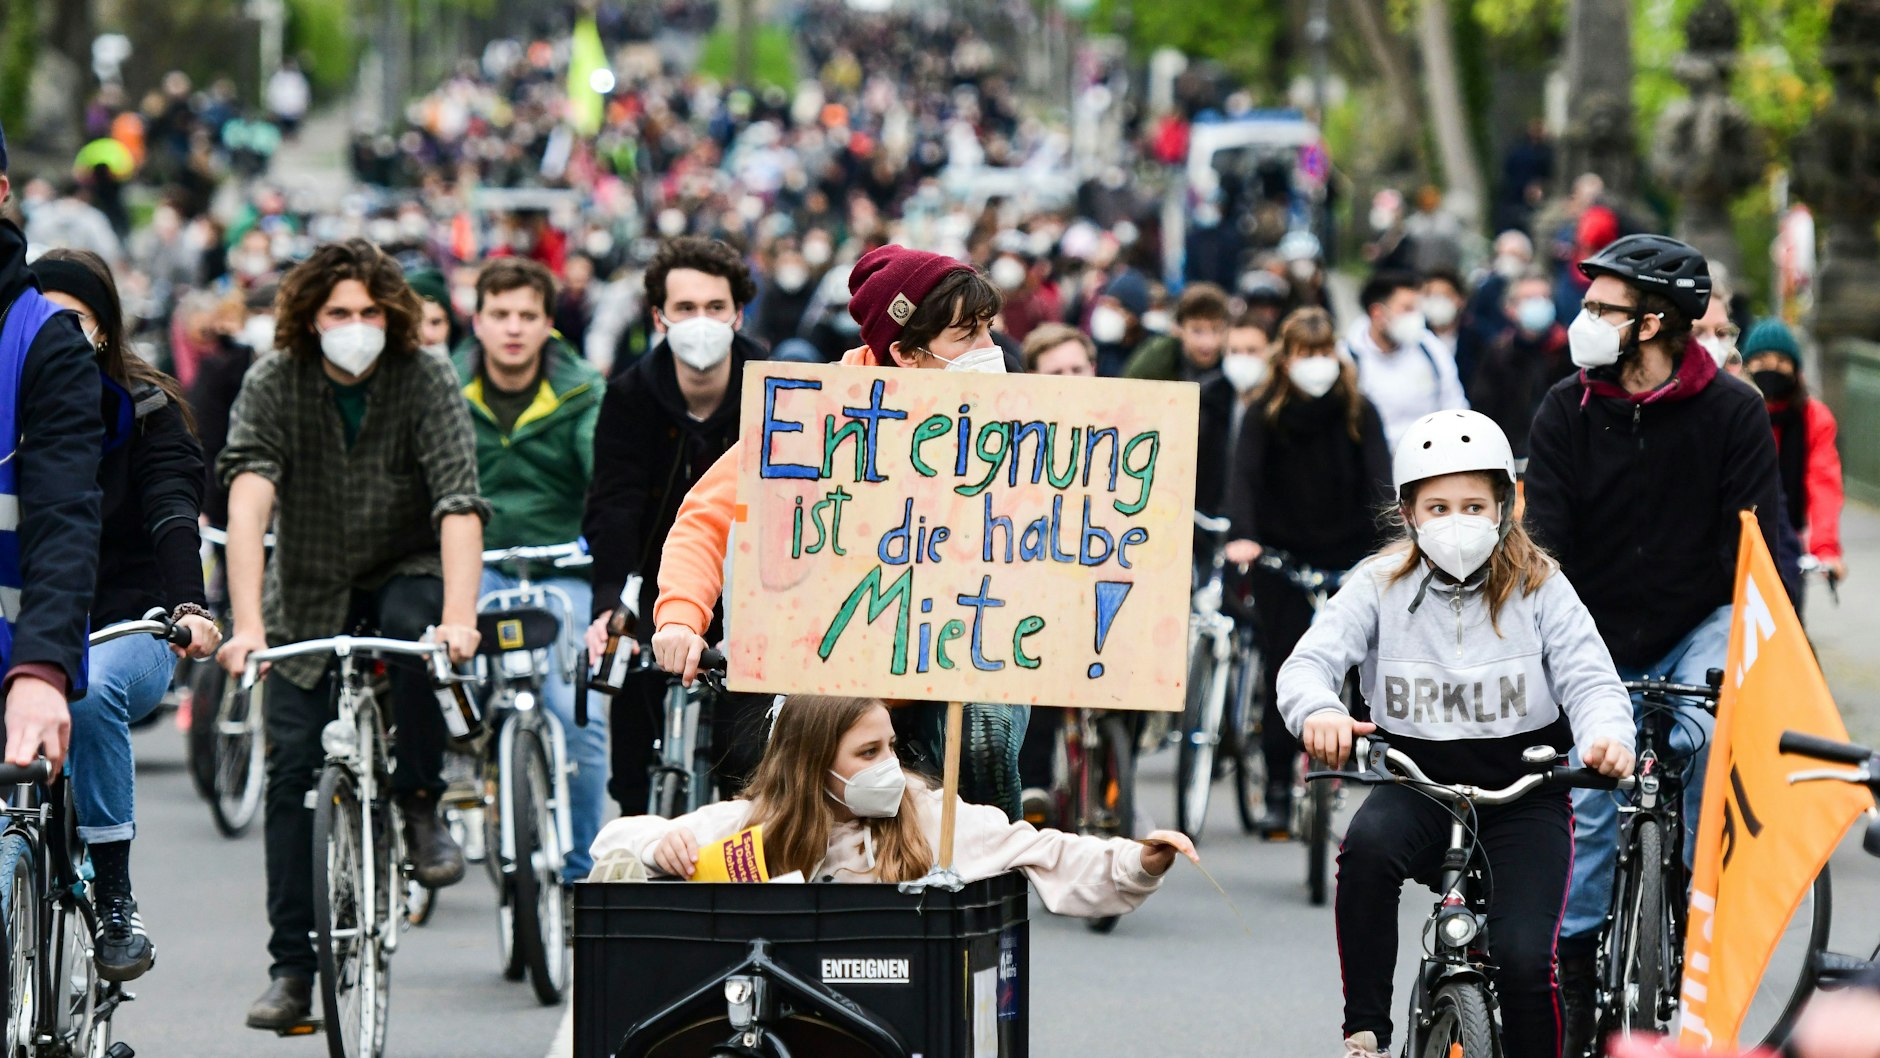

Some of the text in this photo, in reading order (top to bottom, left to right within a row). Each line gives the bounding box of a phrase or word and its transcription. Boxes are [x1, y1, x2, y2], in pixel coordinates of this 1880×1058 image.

[760, 376, 1160, 516] Enteignung
[791, 485, 1149, 569] ist die halbe
[817, 565, 1046, 675] Miete
[1385, 673, 1527, 723] BRKLN
[821, 958, 909, 978] ENTEIGNEN
